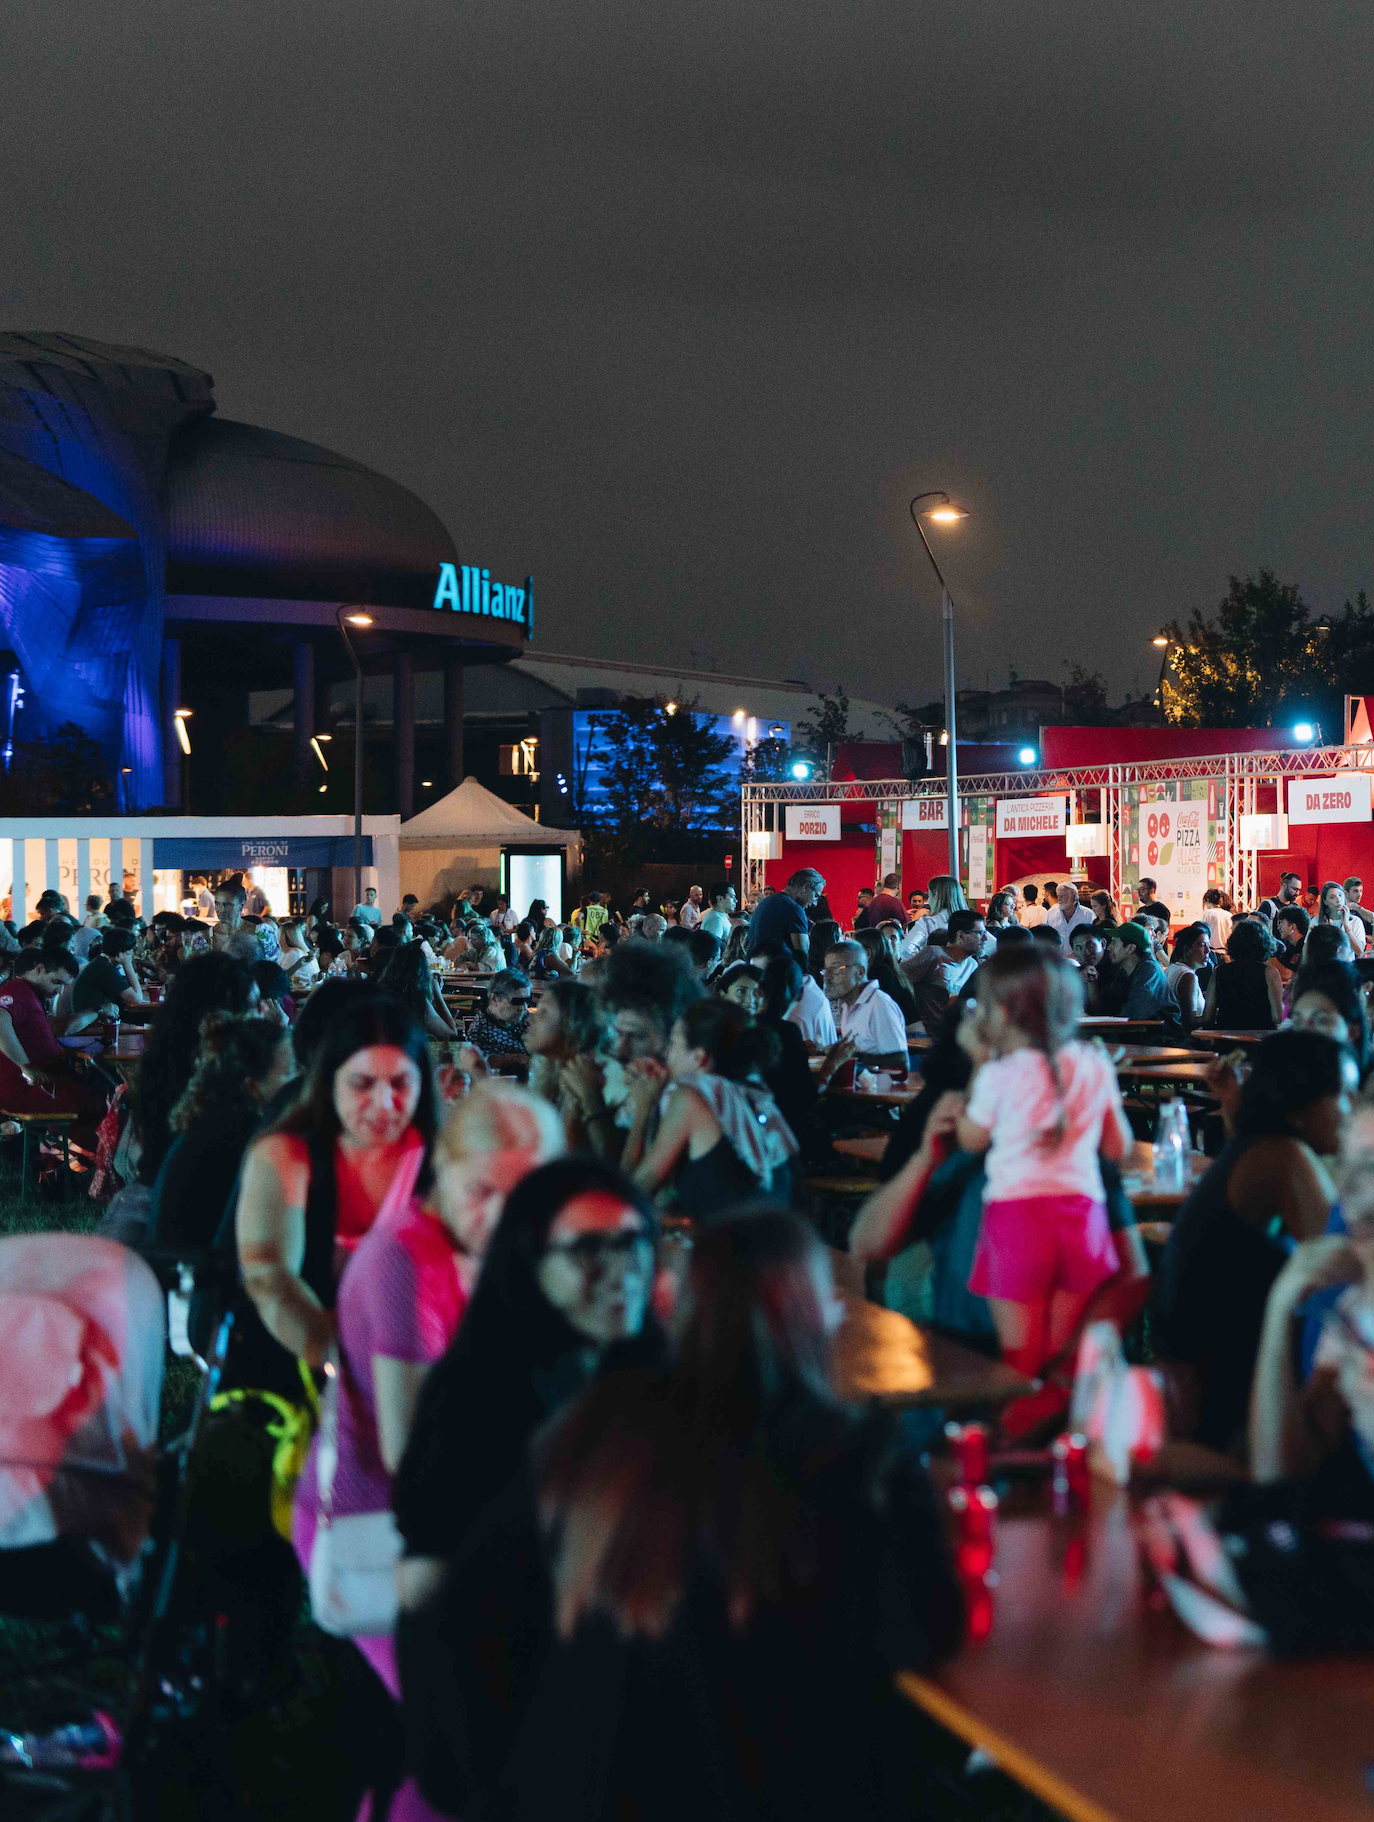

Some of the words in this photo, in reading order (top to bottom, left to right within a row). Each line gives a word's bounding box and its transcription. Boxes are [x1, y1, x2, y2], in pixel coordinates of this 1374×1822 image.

[433, 562, 525, 623] Allianz
[1006, 803, 1030, 814] L'ANTICA
[1030, 802, 1055, 812] PIZZERIA
[1306, 794, 1321, 810] DA
[1322, 791, 1352, 809] ZERO
[804, 810, 820, 818] ERRICO
[919, 801, 944, 821] BAR
[799, 821, 827, 835] PORZIO
[1003, 816, 1016, 832] DA
[1017, 815, 1059, 831] MICHELE
[1176, 829, 1200, 846] PIZZA
[242, 845, 289, 857] PERONI
[1176, 847, 1200, 866] VILLAGE
[1176, 866, 1200, 875] MILANO
